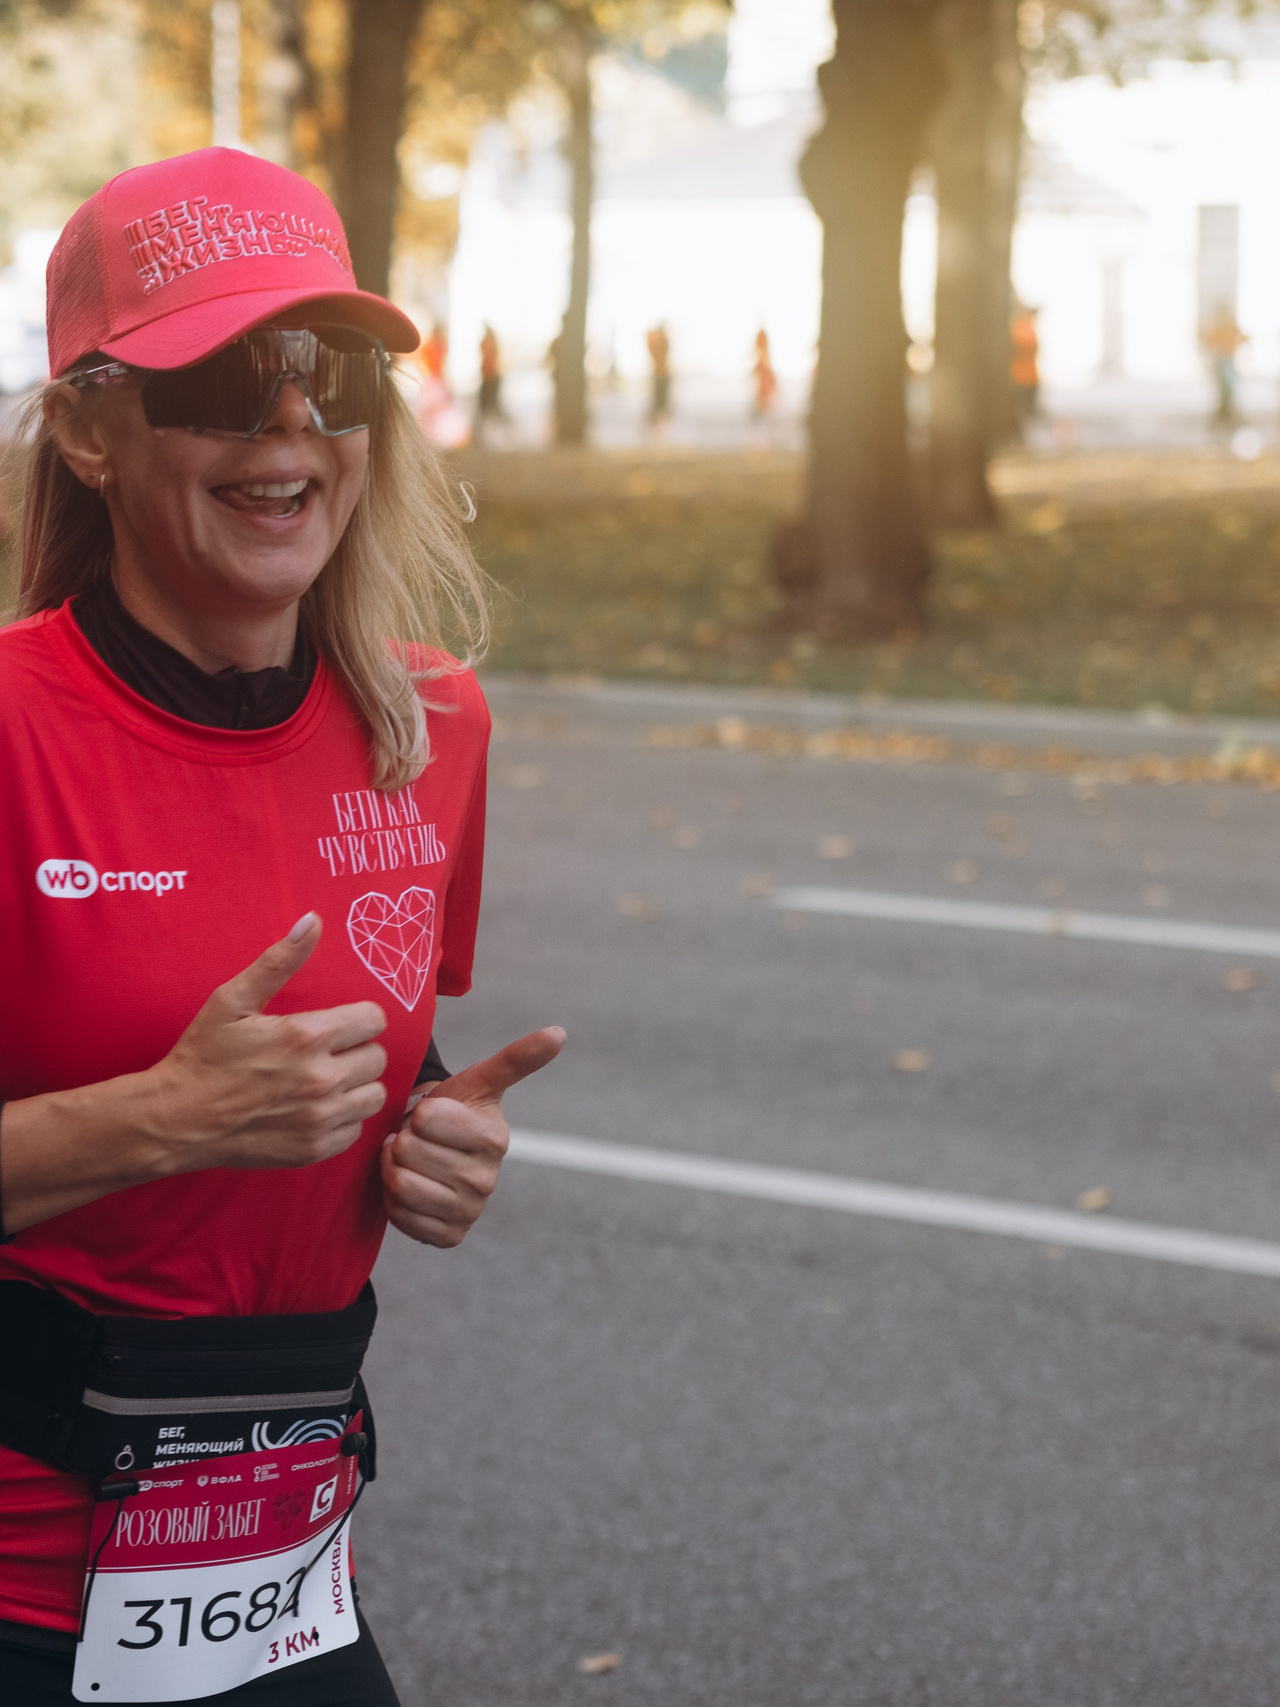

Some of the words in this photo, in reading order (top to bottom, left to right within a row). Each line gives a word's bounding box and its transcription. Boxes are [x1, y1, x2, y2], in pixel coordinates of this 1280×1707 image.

[145, 196, 208, 239] БЕГ
[332, 789, 383, 833] БЕГИ
[384, 783, 422, 827] КАК
[317, 823, 446, 877] ЧУВСТВУЕШЬ
[155, 1438, 245, 1456] МЕНЯЮЩИЙ
[158, 1426, 185, 1439] БЕГ,
[210, 1474, 242, 1485] ВФЛА
[115, 1501, 211, 1548] РОЗОВЫЙ
[211, 1498, 266, 1541] ЗАБЕГ
[331, 1533, 345, 1615] МОСКВА
[116, 1566, 307, 1650] 31682
[268, 1641, 279, 1663] 3
